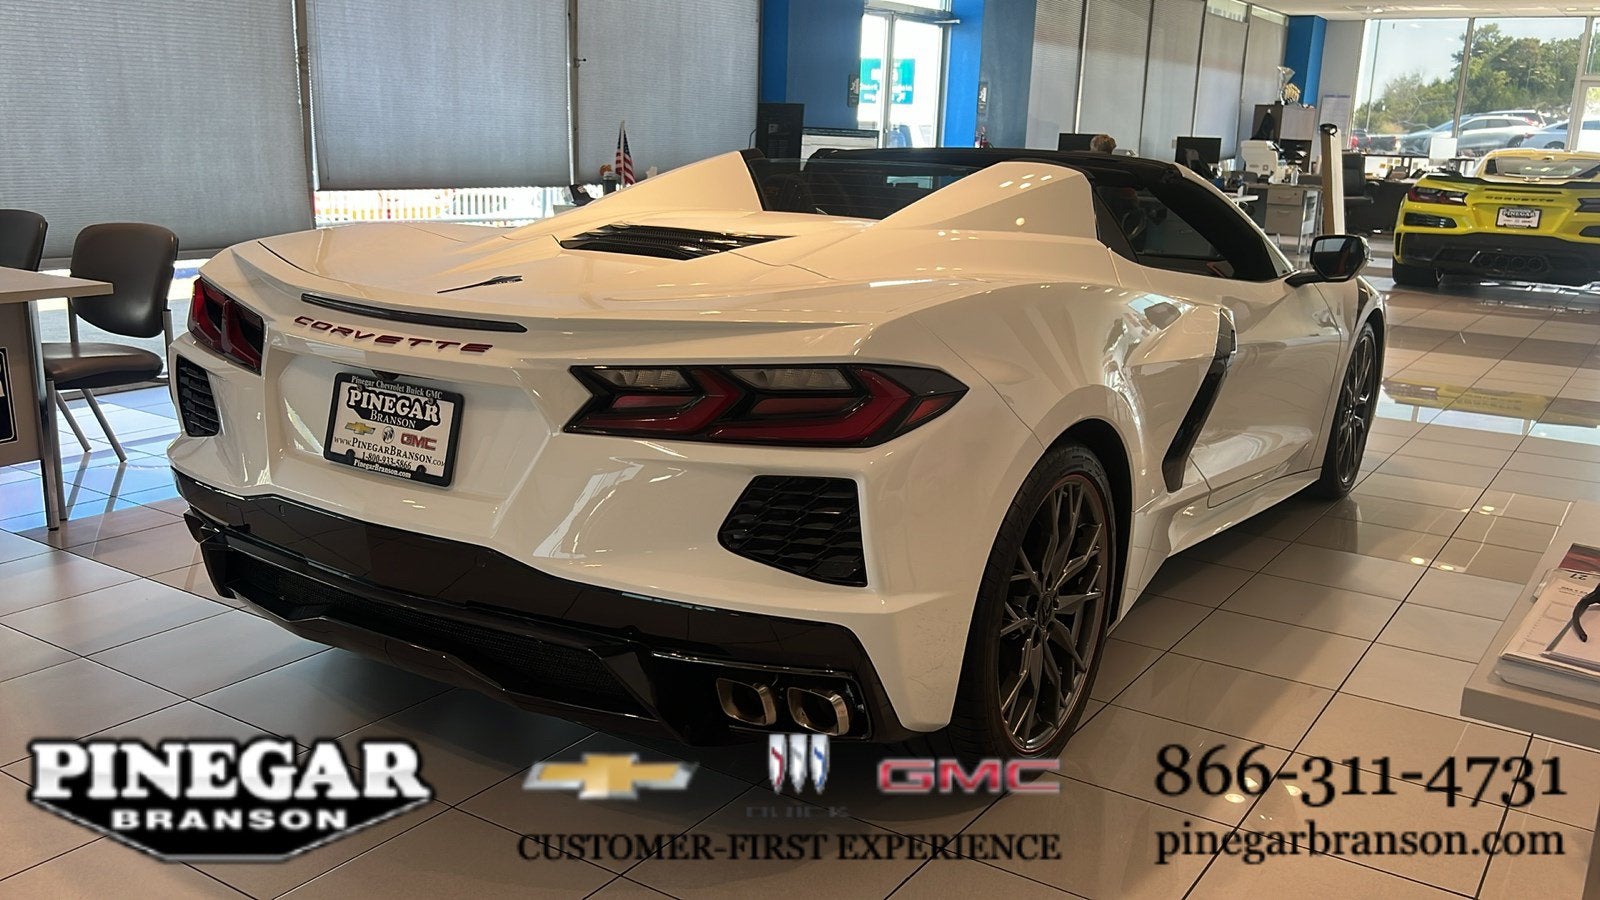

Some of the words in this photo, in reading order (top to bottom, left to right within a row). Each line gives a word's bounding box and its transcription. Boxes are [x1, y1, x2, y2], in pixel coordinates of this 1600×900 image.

[294, 315, 493, 353] CORVETTE
[351, 375, 375, 387] Pinegar
[376, 380, 405, 393] Chevrolet
[405, 386, 424, 397] Buick
[425, 389, 443, 400] GMC
[348, 388, 440, 423] PINEGAR
[400, 432, 438, 451] GMC
[353, 459, 412, 478] PinegarBranson.com
